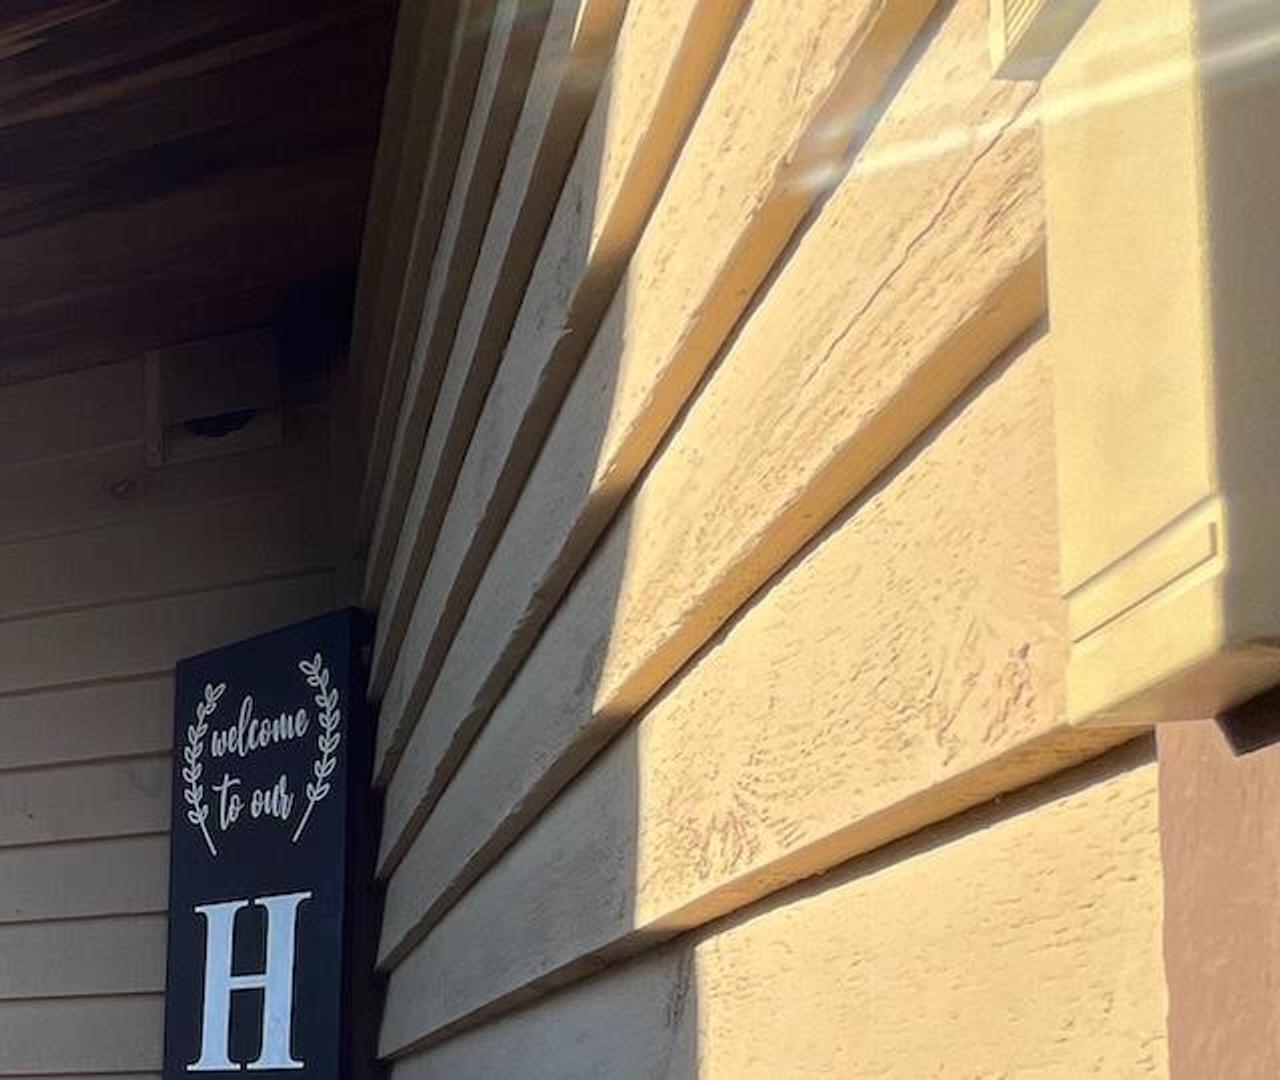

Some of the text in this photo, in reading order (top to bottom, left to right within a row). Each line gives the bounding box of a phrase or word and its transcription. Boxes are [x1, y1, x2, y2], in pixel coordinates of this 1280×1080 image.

[211, 695, 309, 757] welcome
[211, 773, 295, 831] to our
